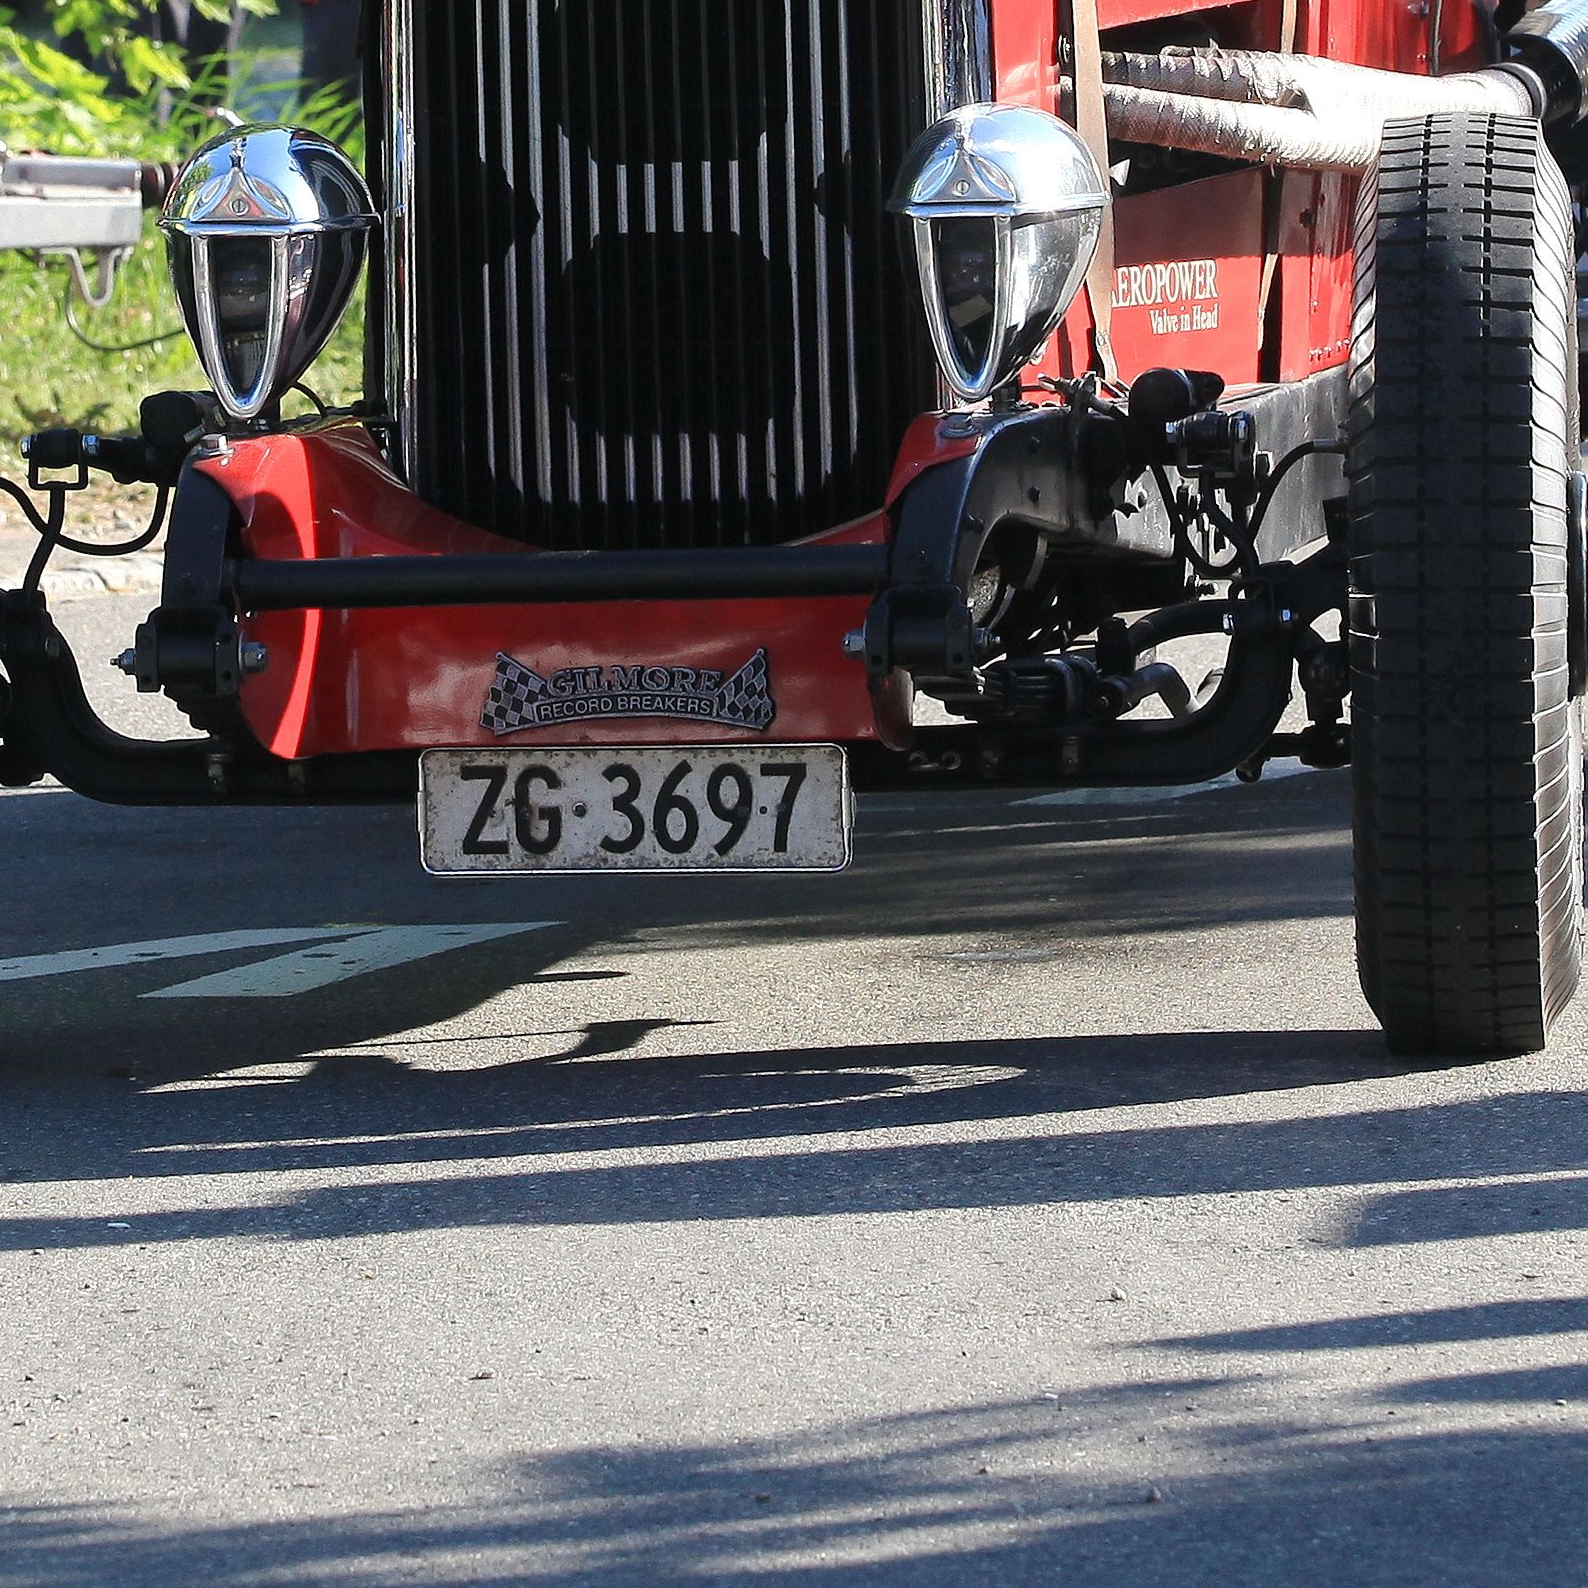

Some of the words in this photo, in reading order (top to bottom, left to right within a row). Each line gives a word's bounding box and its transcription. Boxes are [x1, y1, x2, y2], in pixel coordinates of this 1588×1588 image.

[1149, 308, 1179, 335] Valve
[1180, 306, 1191, 332] in
[1192, 303, 1219, 330] Head
[546, 666, 723, 696] GILMORE
[539, 697, 613, 720] RECORD
[617, 696, 711, 715] BREAKERS
[460, 765, 562, 855] ZG
[600, 759, 808, 856] 3697
